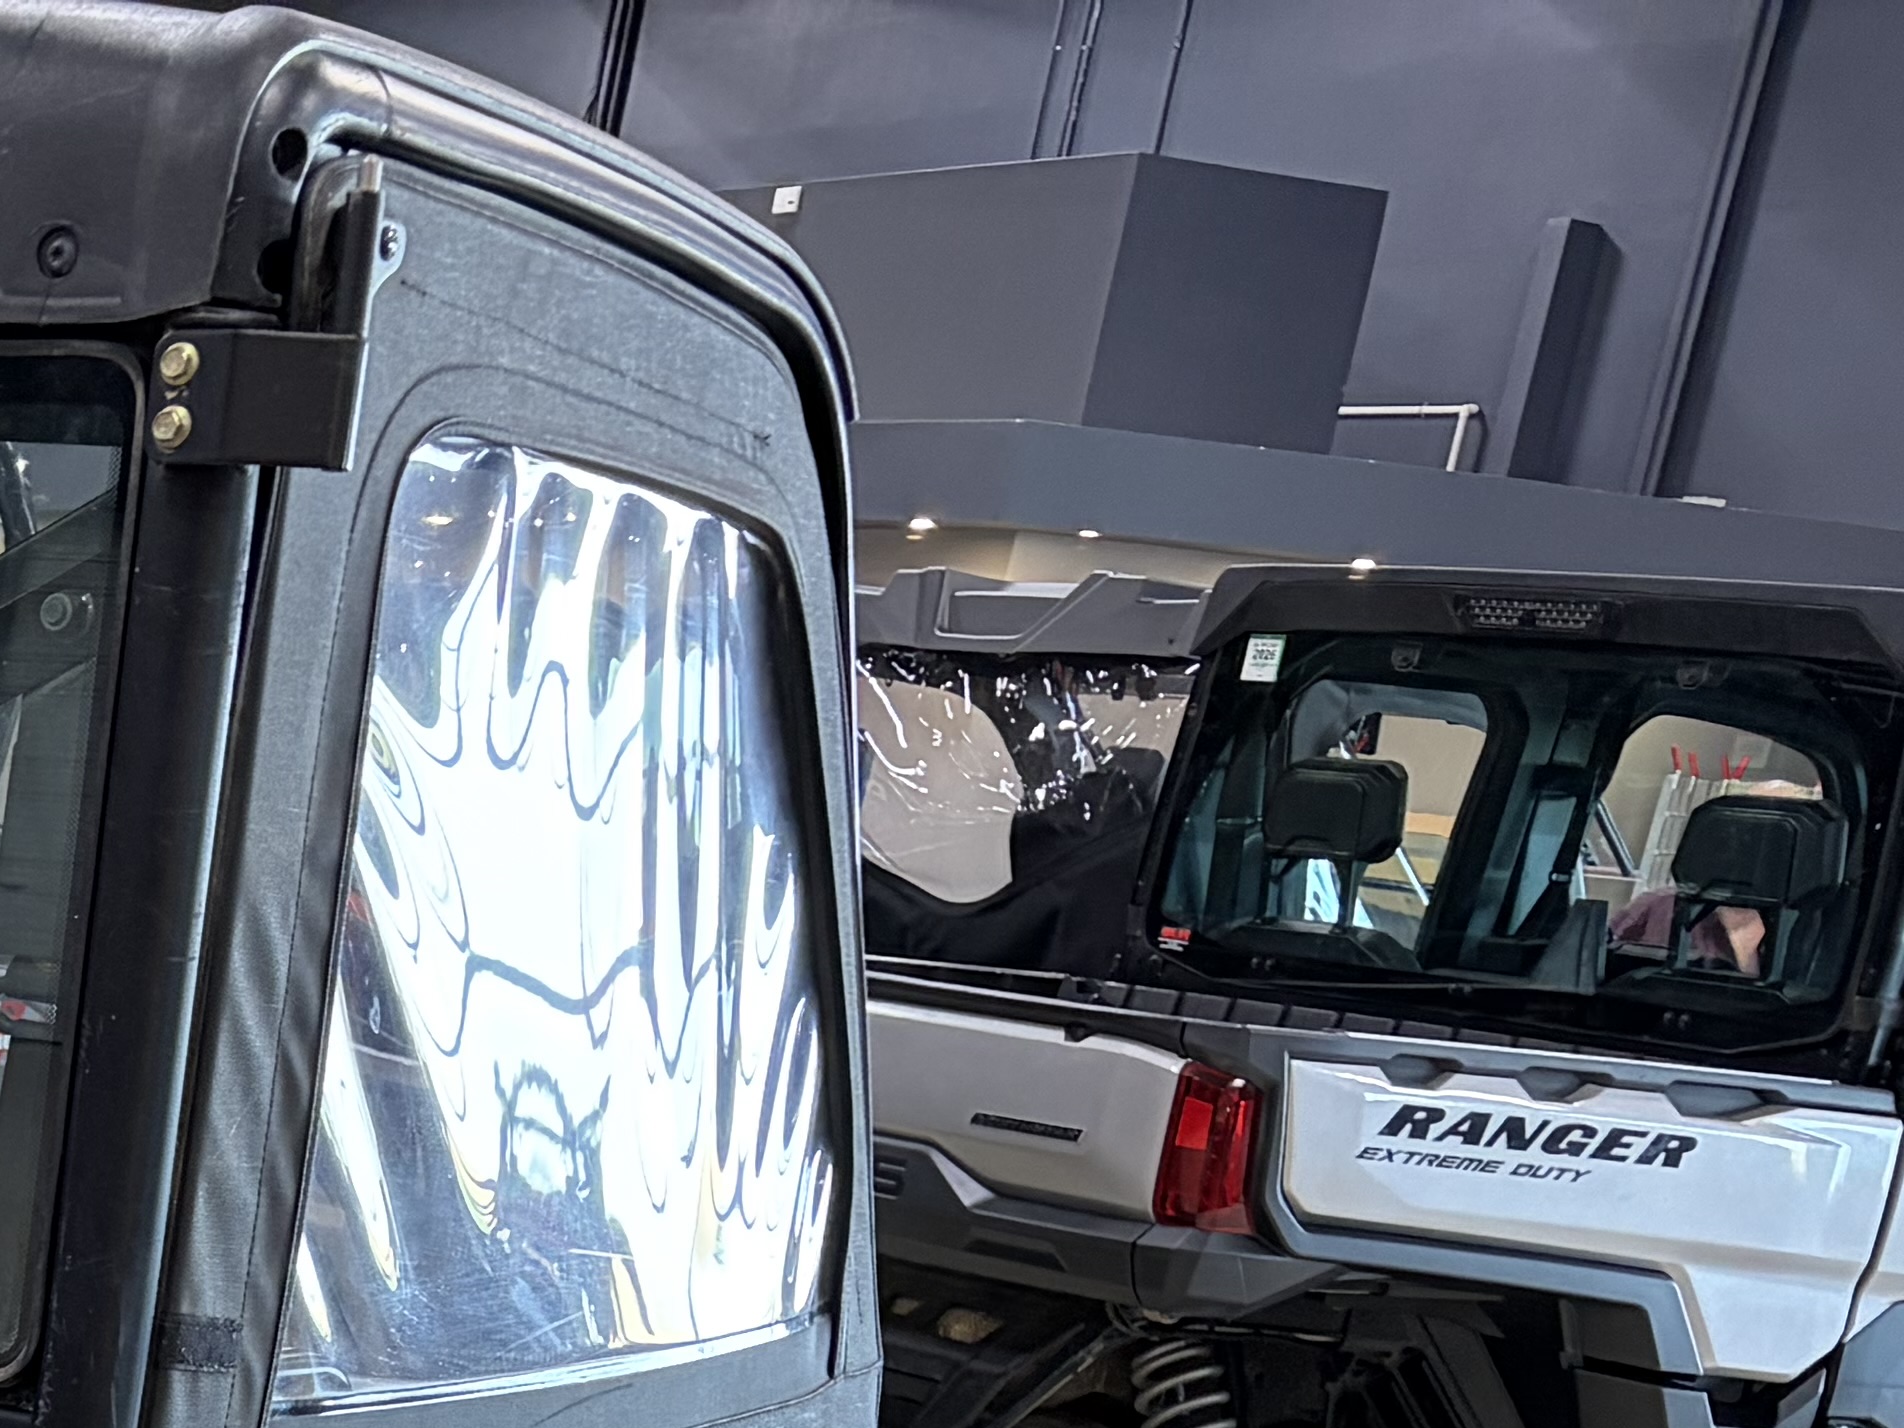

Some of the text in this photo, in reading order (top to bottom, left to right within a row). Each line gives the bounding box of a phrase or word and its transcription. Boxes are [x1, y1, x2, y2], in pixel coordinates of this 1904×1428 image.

[1377, 1103, 1699, 1169] RANGER
[1355, 1146, 1593, 1184] EXTREME DUTY
